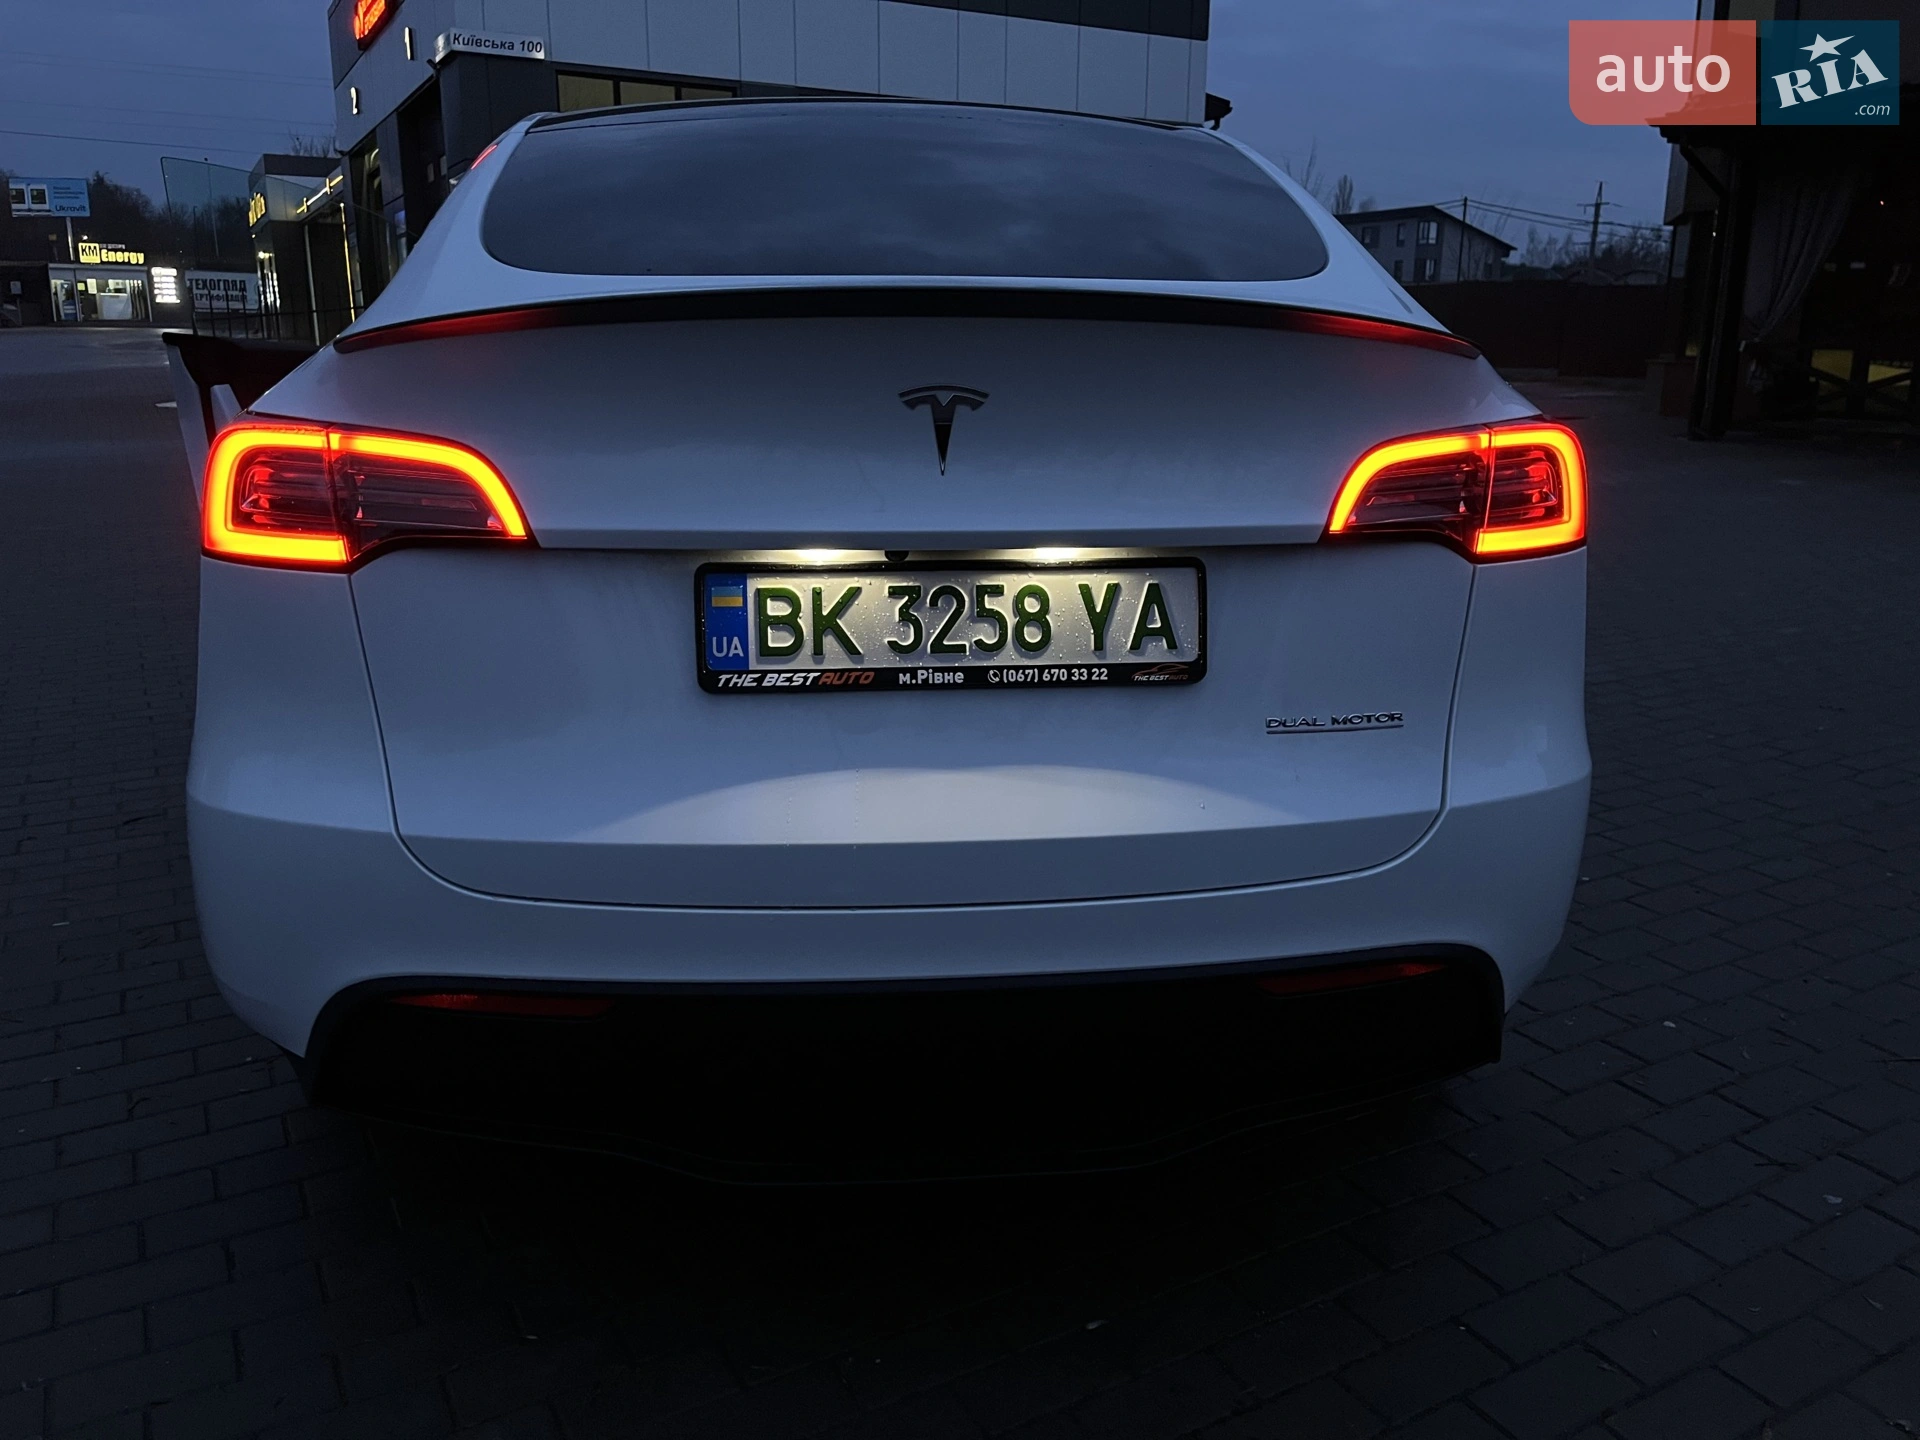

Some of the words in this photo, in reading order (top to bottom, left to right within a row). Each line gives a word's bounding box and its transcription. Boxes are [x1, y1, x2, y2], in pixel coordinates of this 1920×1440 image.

[452, 32, 515, 51] Київська
[519, 40, 543, 53] 100
[55, 204, 87, 212] Ukravit
[101, 248, 144, 264] Energy
[757, 585, 863, 657] BK
[885, 584, 1052, 655] 3258
[712, 636, 744, 658] UA
[717, 673, 762, 687] THE
[1003, 668, 1038, 682] (067)
[1042, 668, 1067, 681] 670
[1071, 667, 1088, 680] 33
[1091, 667, 1108, 680] 22
[1266, 716, 1325, 728] DUAL
[1331, 711, 1403, 726] MOTOR
